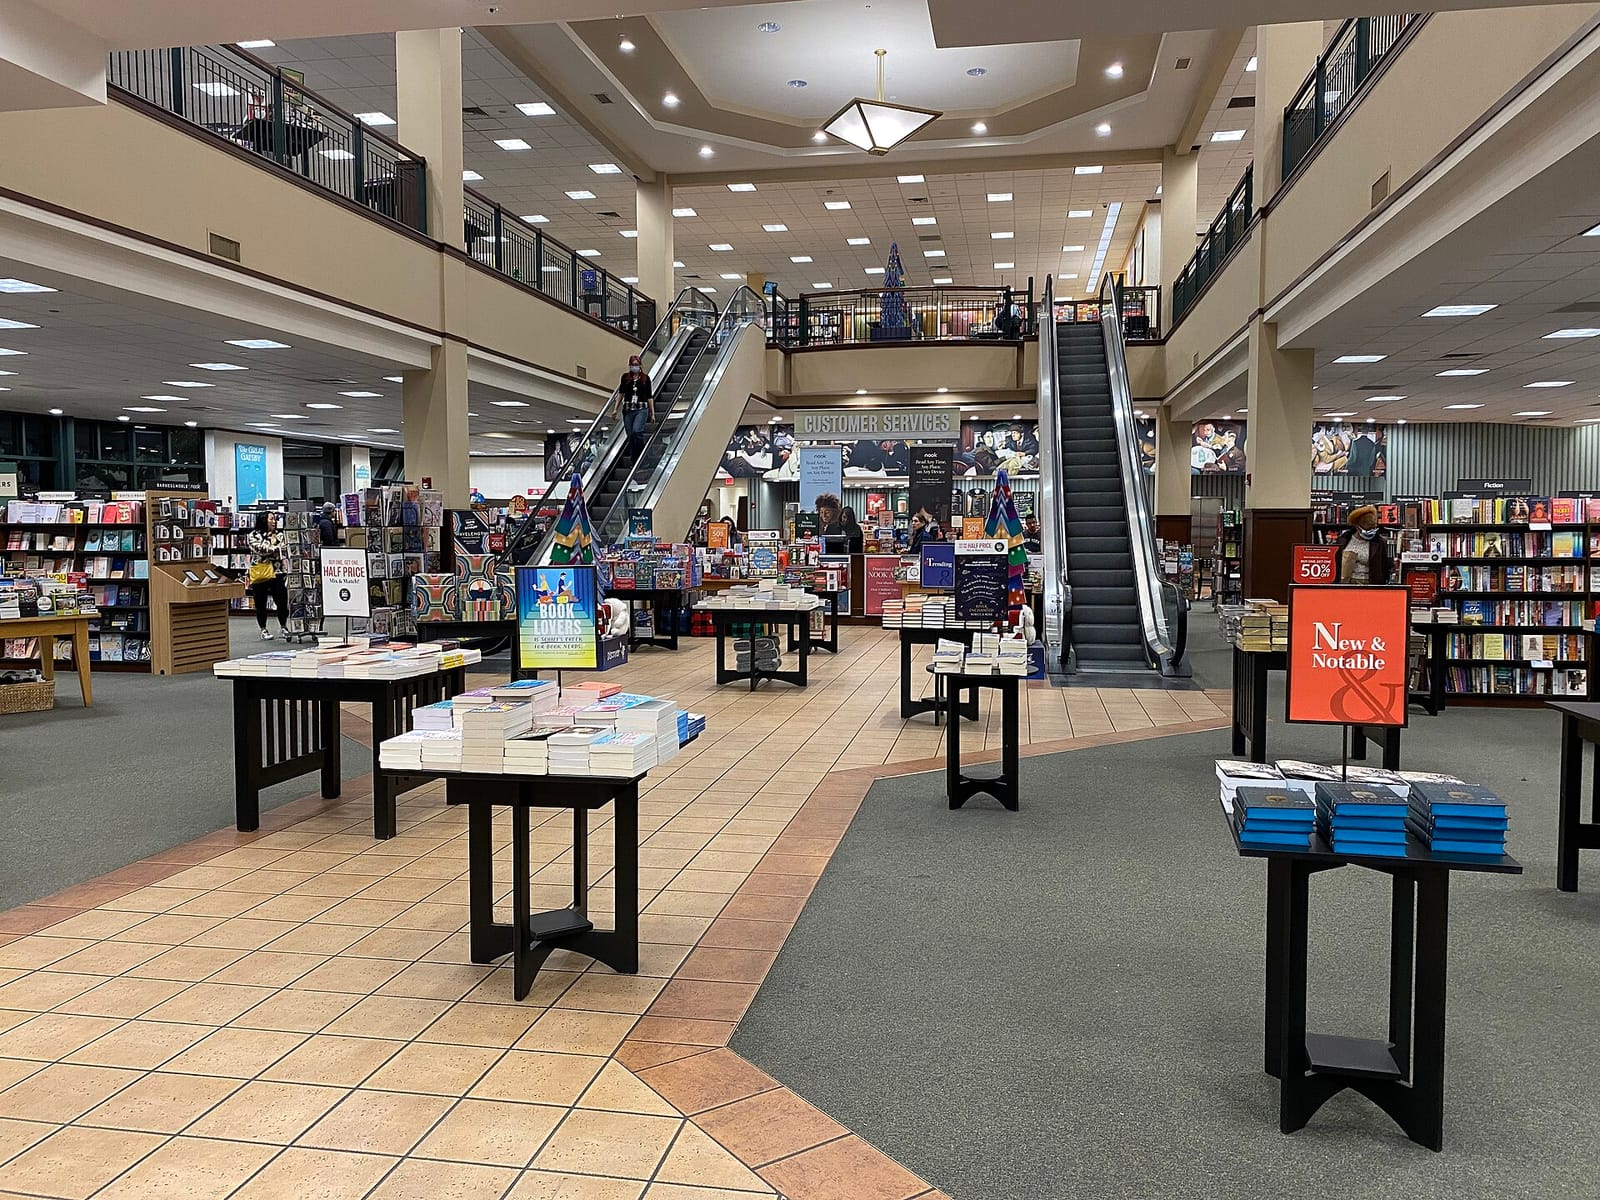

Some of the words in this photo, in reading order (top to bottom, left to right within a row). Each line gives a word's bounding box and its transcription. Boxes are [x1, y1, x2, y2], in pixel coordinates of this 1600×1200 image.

[804, 415, 878, 433] CUSTOMER
[882, 413, 950, 432] SERVICES
[240, 453, 262, 462] GATSBY
[1483, 481, 1504, 489] Fiction
[925, 557, 953, 569] Trending
[1300, 563, 1331, 578] 50%
[323, 566, 342, 577] HALF
[342, 566, 366, 578] PRICE
[540, 603, 575, 619] BOOK
[533, 619, 582, 636] LOVERS
[1312, 622, 1366, 651] New
[1370, 636, 1386, 652] &
[1311, 652, 1386, 671] Notable
